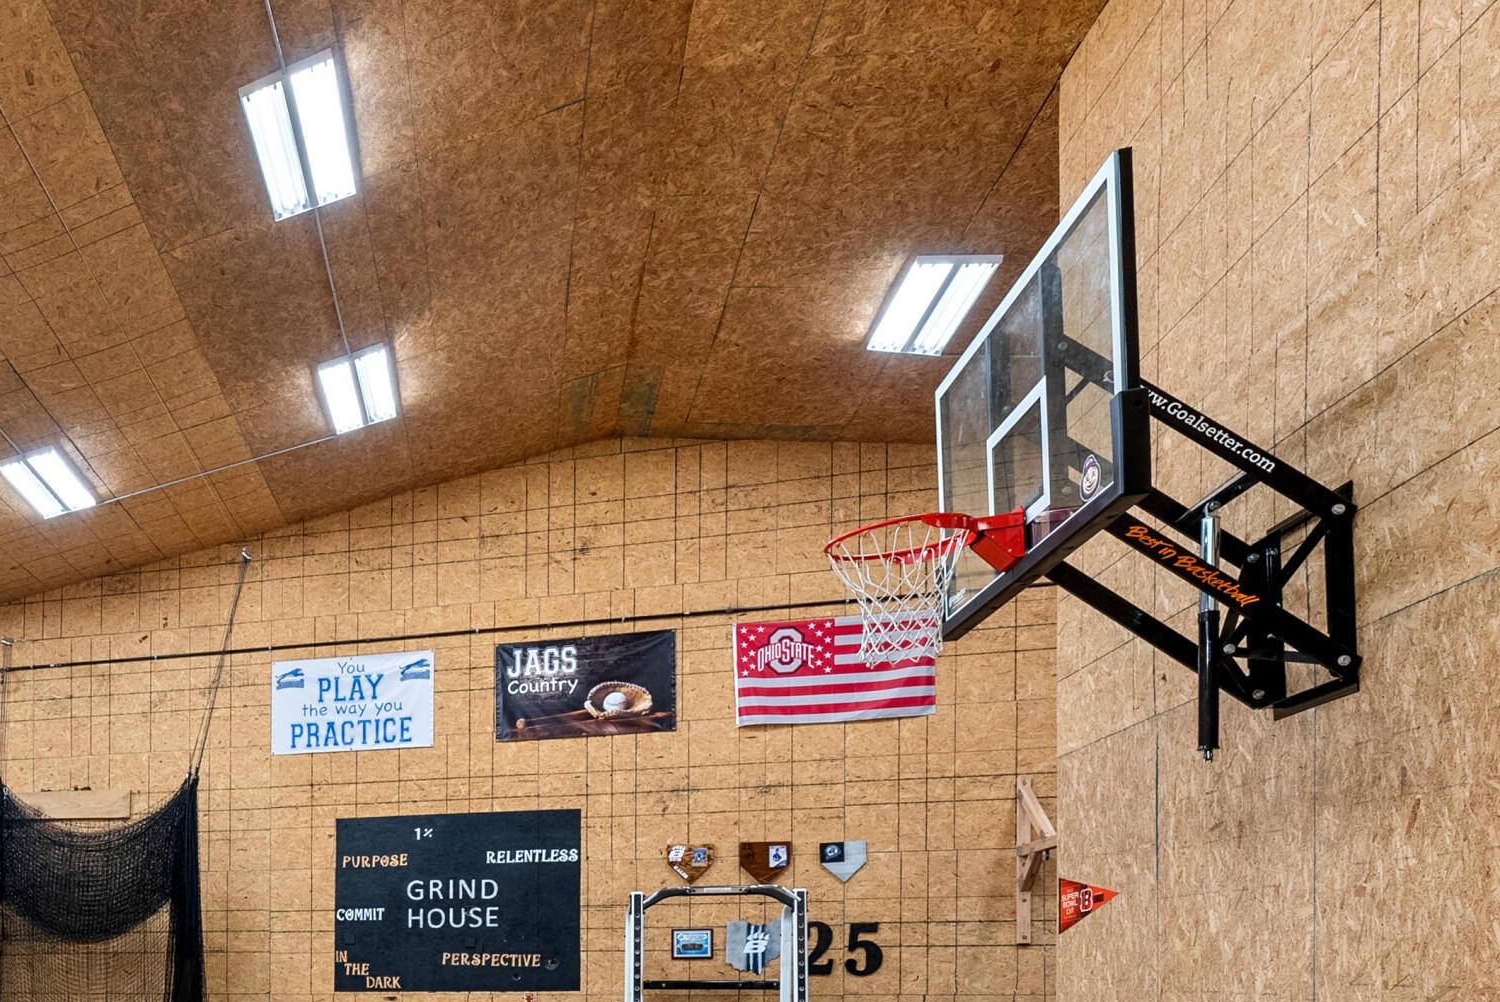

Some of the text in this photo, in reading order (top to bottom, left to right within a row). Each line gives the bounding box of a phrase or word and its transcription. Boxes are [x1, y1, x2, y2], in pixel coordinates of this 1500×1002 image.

[1140, 384, 1276, 474] w.Goalsetter.com
[1125, 525, 1260, 608] Best in Basketball
[337, 661, 366, 675] You
[507, 644, 577, 678] JAGS
[318, 674, 384, 703] PLAY
[507, 678, 579, 695] Country
[302, 701, 403, 717] the way you
[290, 716, 412, 749] PRACTICE
[414, 827, 434, 841] 1%
[342, 854, 408, 868] PURPOSE
[486, 849, 579, 864] RELENTLESS
[406, 879, 499, 900] GRIND
[336, 907, 385, 921] COMMIT
[407, 906, 499, 928] HOUSE
[336, 950, 348, 963] IN
[807, 921, 884, 977] 25
[441, 952, 541, 967] PERSPECTIVE
[344, 963, 370, 976] THE
[366, 976, 401, 989] DARK
